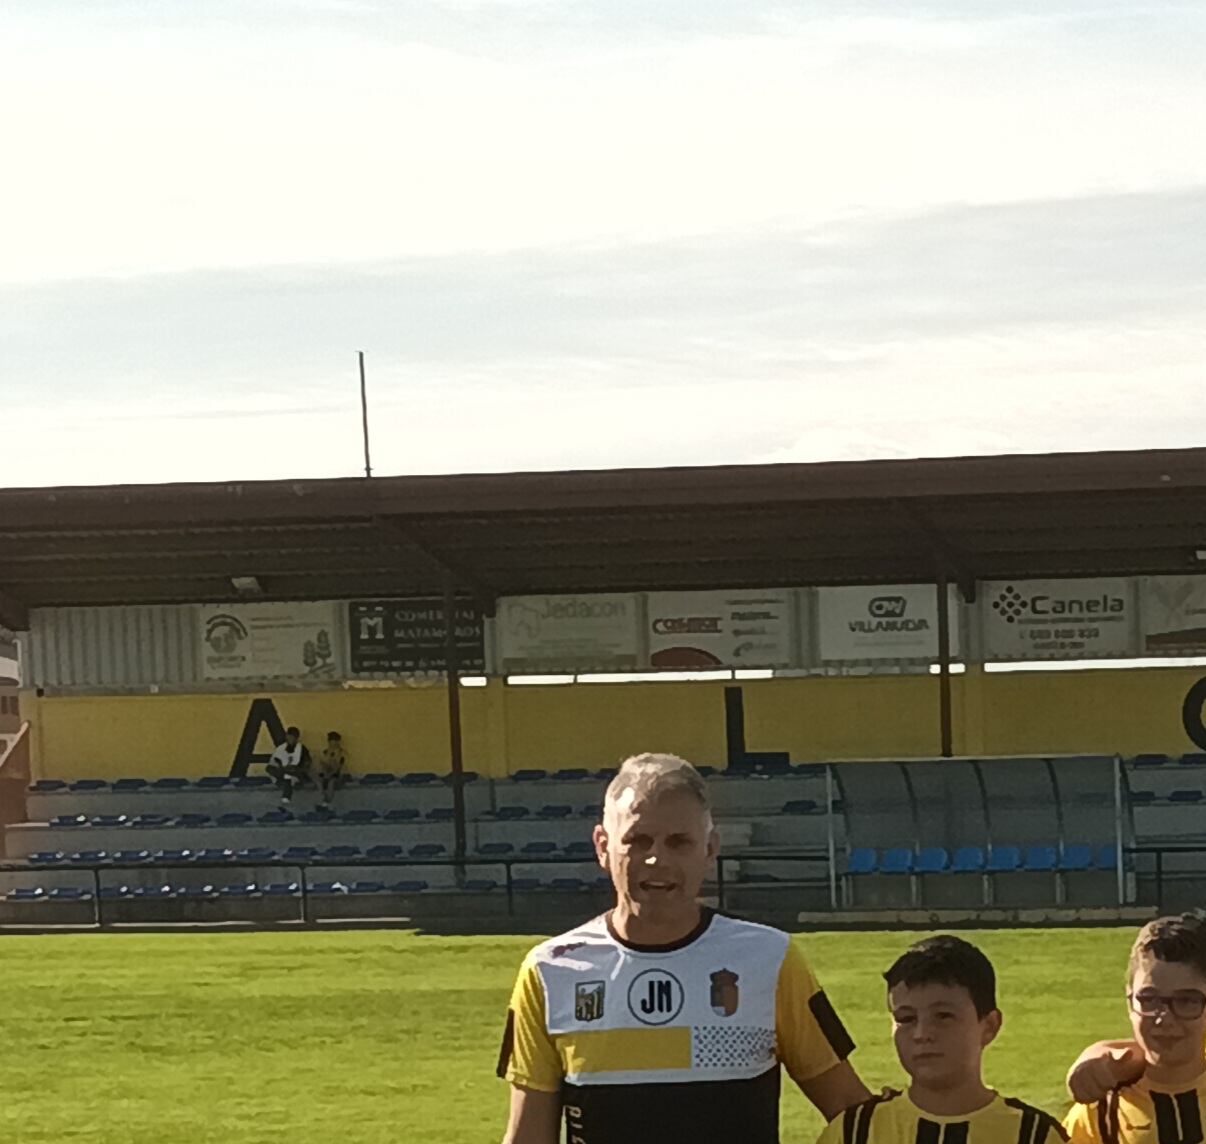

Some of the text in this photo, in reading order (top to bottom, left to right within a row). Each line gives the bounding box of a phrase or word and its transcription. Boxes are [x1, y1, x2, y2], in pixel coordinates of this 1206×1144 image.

[1031, 594, 1124, 614] Canela
[394, 609, 474, 622] COMERIAL
[394, 626, 480, 639] MATAMROS
